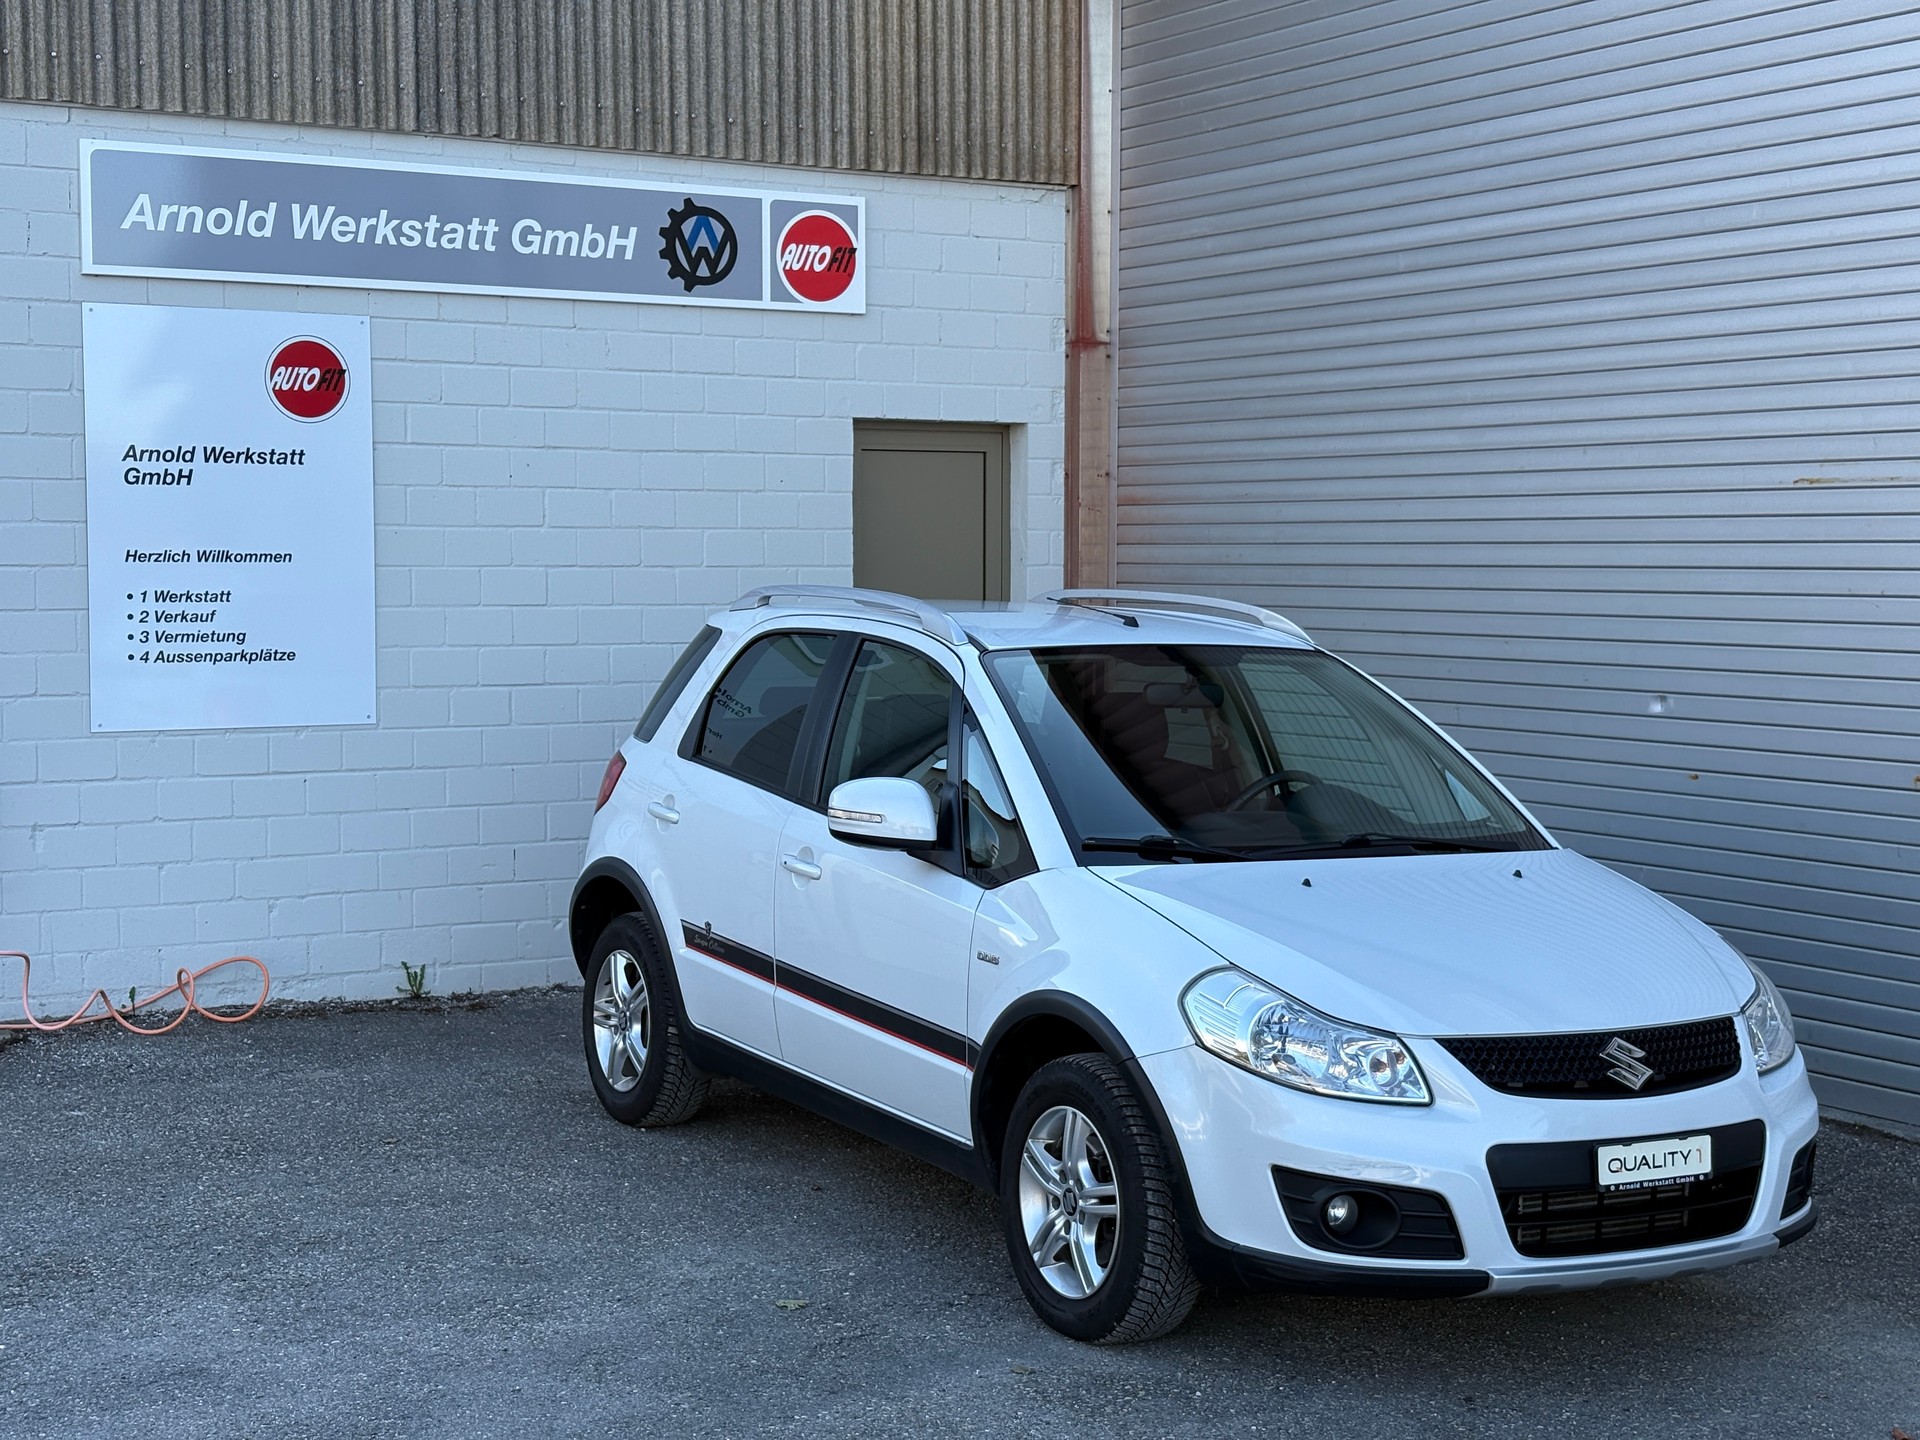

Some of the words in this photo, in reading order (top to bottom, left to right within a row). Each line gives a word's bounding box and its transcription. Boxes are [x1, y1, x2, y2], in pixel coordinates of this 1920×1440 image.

[120, 193, 277, 238] Arnold
[291, 203, 498, 252] Werkstatt
[511, 218, 637, 260] GmbH
[781, 243, 857, 274] AUTOFIT
[270, 366, 347, 392] AUTOFIT
[121, 444, 196, 464] Arnold
[202, 446, 306, 466] Werkstatt
[123, 467, 194, 486] GmbH
[124, 549, 191, 563] Herzlich
[196, 549, 293, 563] Willkommen
[140, 590, 148, 603] 1
[153, 590, 232, 603] Werkstatt
[139, 610, 149, 624] 2
[154, 610, 217, 623] Verkauf
[139, 630, 150, 644] 3
[154, 630, 247, 645] Vermietung
[139, 650, 150, 664] 4
[153, 649, 297, 666] Aussenparkplätze
[1608, 1149, 1692, 1173] QUALITY
[1618, 1182, 1641, 1191] Arnold
[1643, 1178, 1675, 1187] Werkstatt
[1675, 1175, 1695, 1183] GmbH
